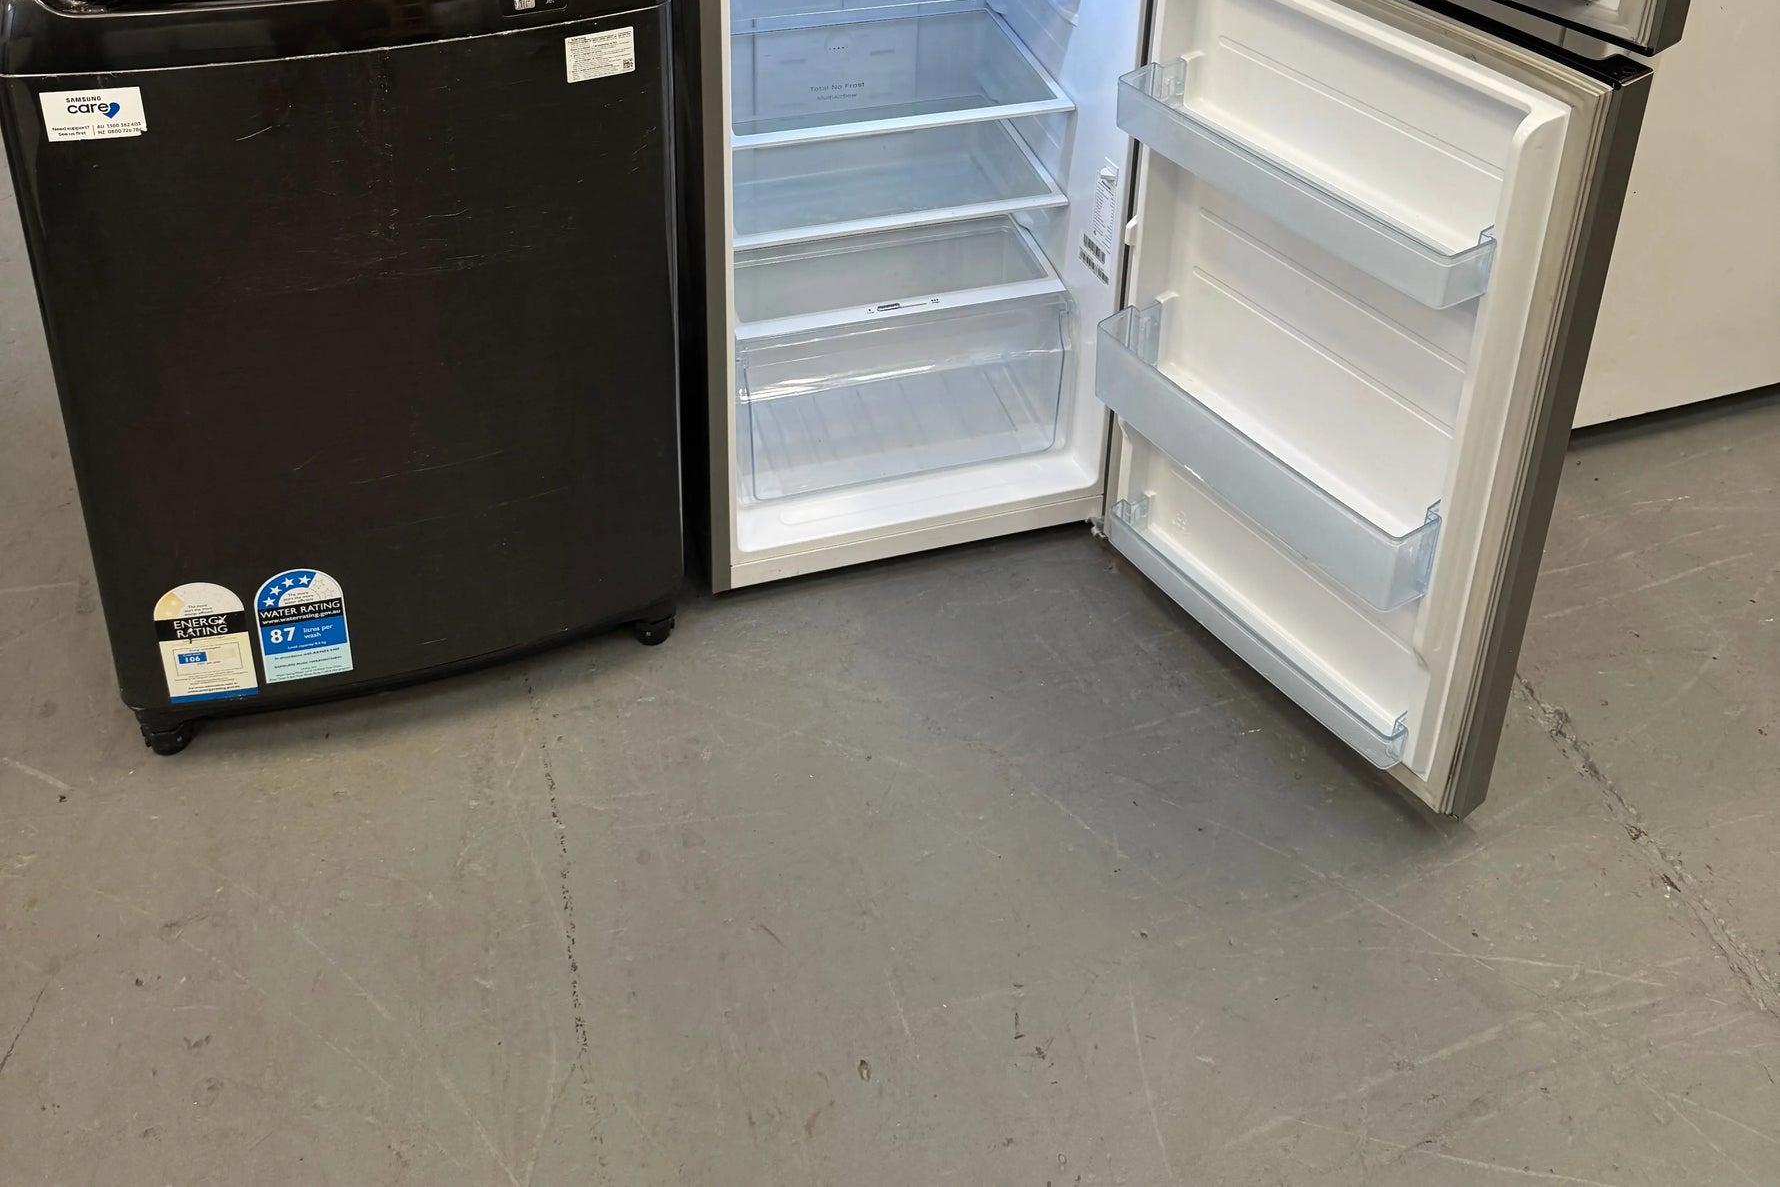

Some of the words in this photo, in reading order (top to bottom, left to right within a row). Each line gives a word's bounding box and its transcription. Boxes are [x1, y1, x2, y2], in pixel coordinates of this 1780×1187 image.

[65, 95, 102, 103] SAMSUNG
[67, 102, 109, 114] care
[259, 608, 298, 619] WATER
[300, 600, 341, 614] RATING
[173, 615, 228, 630] ENERGY
[176, 625, 229, 639] RATING
[270, 626, 296, 644] 87
[185, 655, 201, 663] 106
